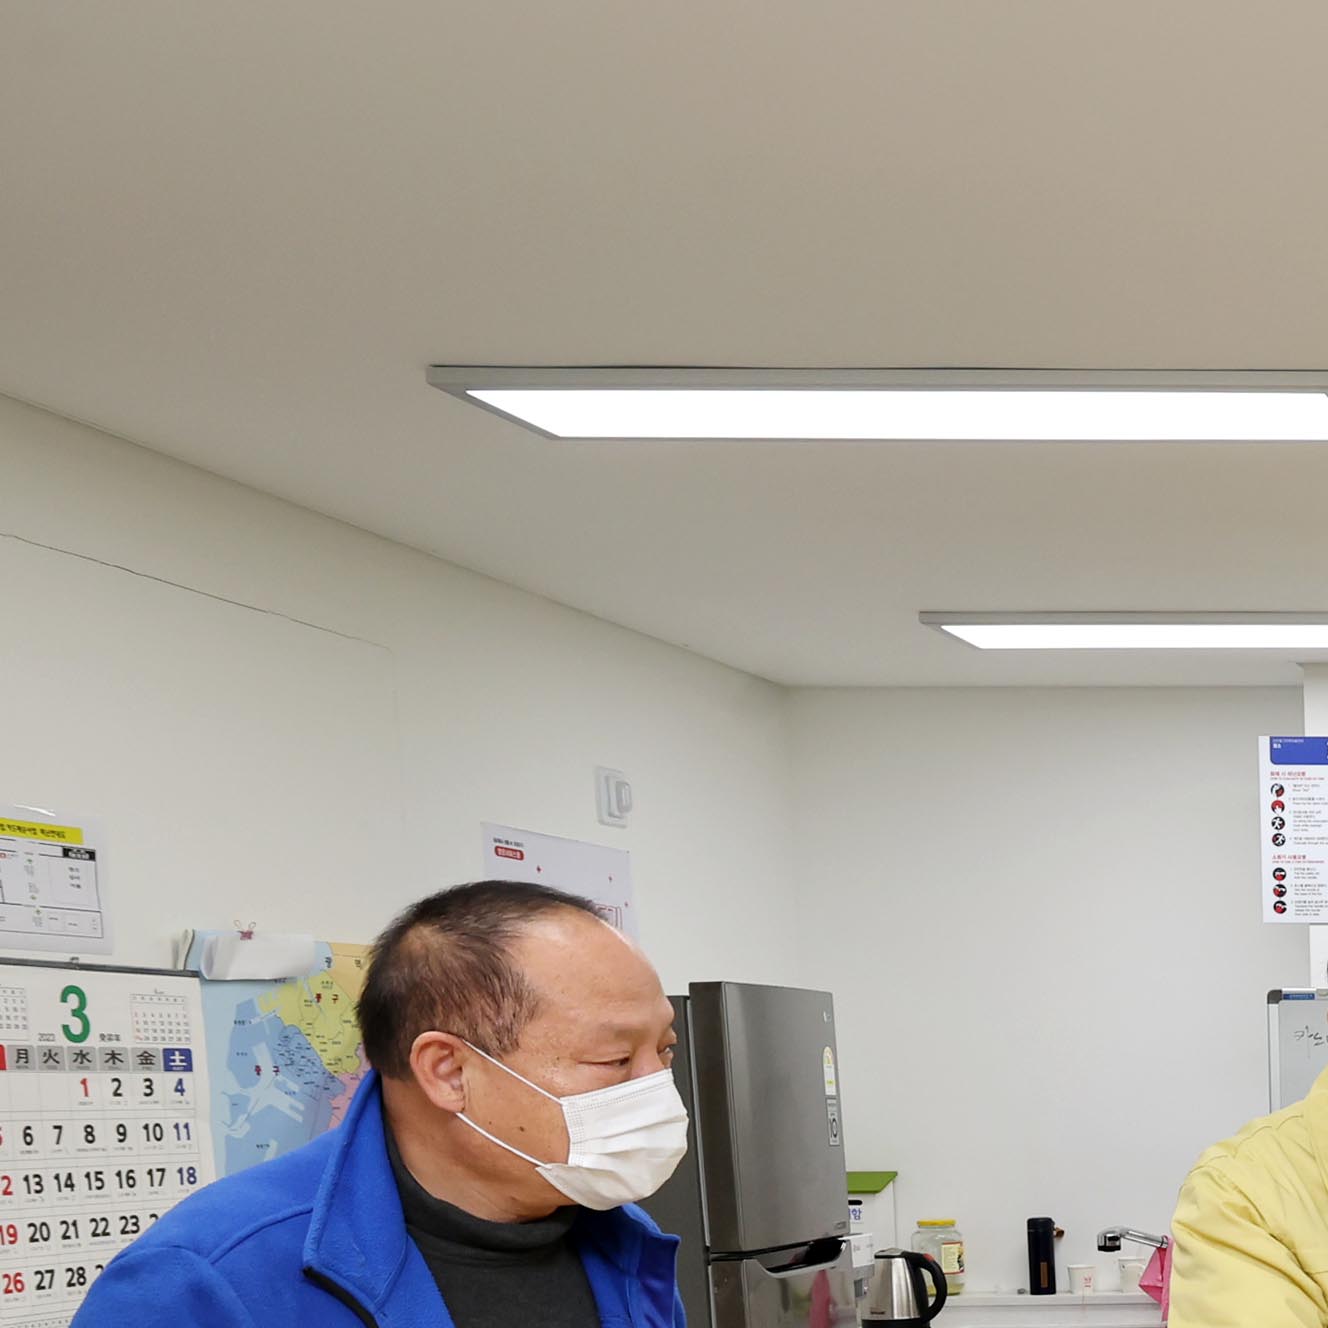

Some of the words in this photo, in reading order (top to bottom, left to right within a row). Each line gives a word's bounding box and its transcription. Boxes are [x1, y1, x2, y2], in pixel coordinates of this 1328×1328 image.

[60, 985, 91, 1043] 3
[15, 1048, 29, 1064] 月
[42, 1049, 60, 1065] 火
[72, 1049, 93, 1065] 水
[103, 1049, 125, 1065] 木
[136, 1050, 157, 1066] 金
[168, 1050, 188, 1066] 土
[80, 1077, 89, 1098] 1
[111, 1077, 124, 1098] 2
[142, 1077, 155, 1098] 3
[173, 1077, 186, 1097] 4
[22, 1125, 34, 1146] 6
[52, 1124, 63, 1145] 7
[83, 1124, 96, 1144] 8
[116, 1123, 128, 1143] 9
[142, 1122, 164, 1142] 10
[173, 1121, 191, 1142] 11
[0, 1175, 14, 1196] 2
[22, 1173, 45, 1195] 13
[53, 1172, 76, 1193] 14
[84, 1170, 105, 1191] 15
[115, 1168, 137, 1189] 16
[146, 1167, 167, 1188] 17
[176, 1166, 198, 1186] 18
[0, 1223, 19, 1246] 19
[27, 1221, 51, 1243] 20
[59, 1219, 80, 1241] 21
[89, 1216, 112, 1238] 22
[118, 1214, 141, 1235] 23
[2, 1272, 25, 1295] 26
[33, 1269, 55, 1291] 27
[65, 1266, 87, 1288] 28
